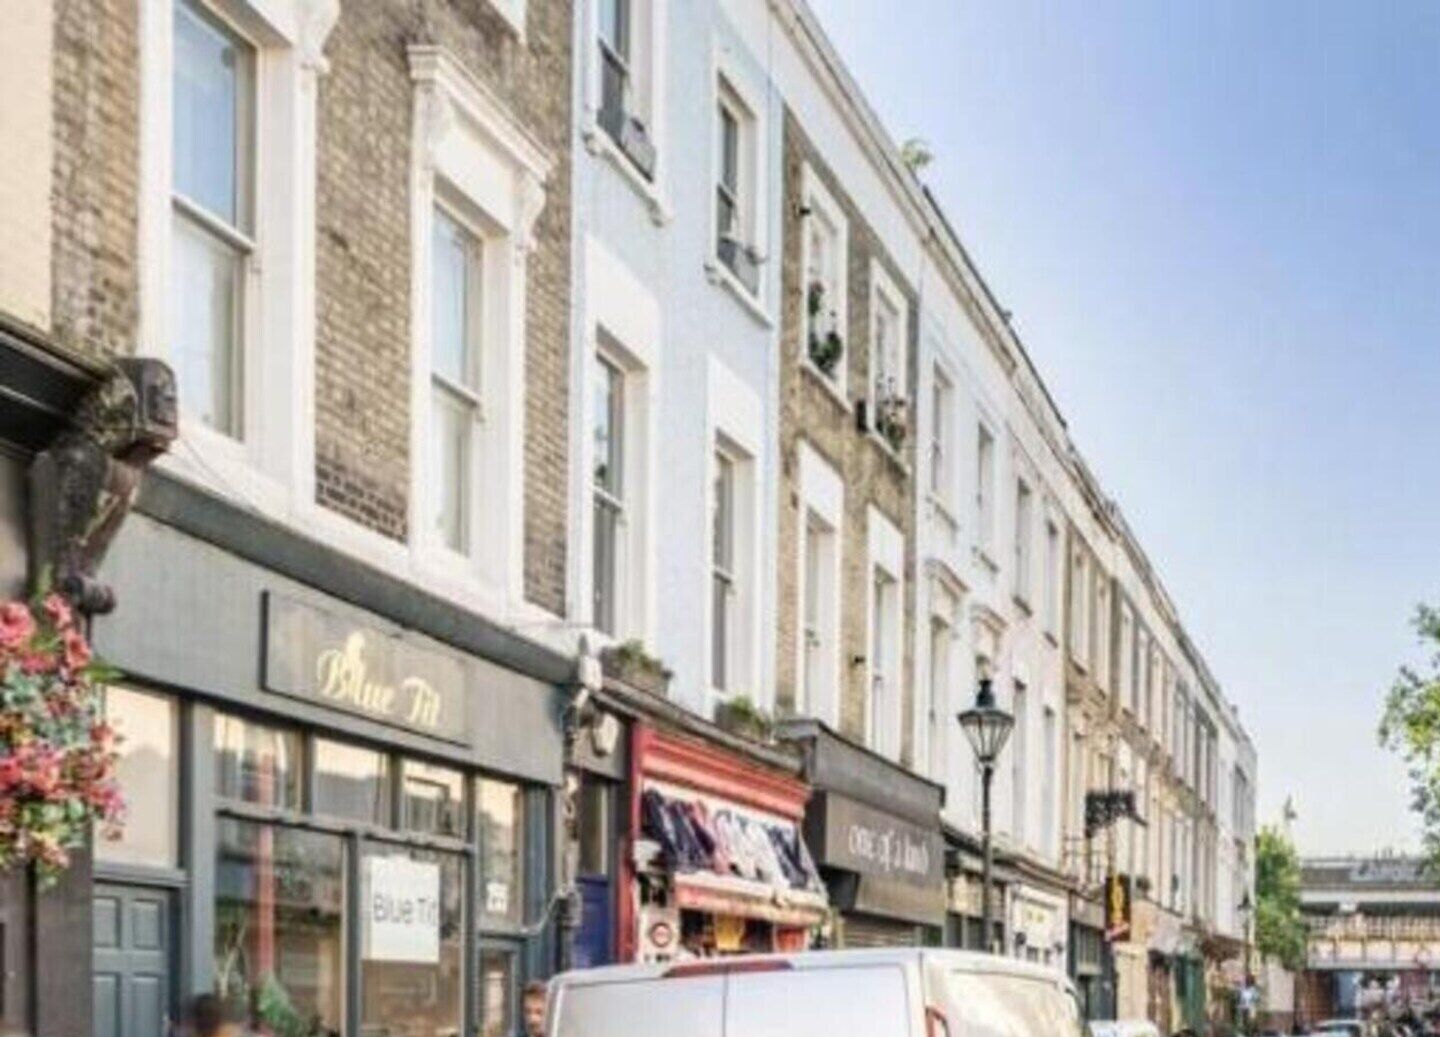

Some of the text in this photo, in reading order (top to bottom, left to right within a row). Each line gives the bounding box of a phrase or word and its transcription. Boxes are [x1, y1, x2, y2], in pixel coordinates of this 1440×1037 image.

[317, 640, 441, 727] Blue Tit
[373, 893, 415, 924] Blue
